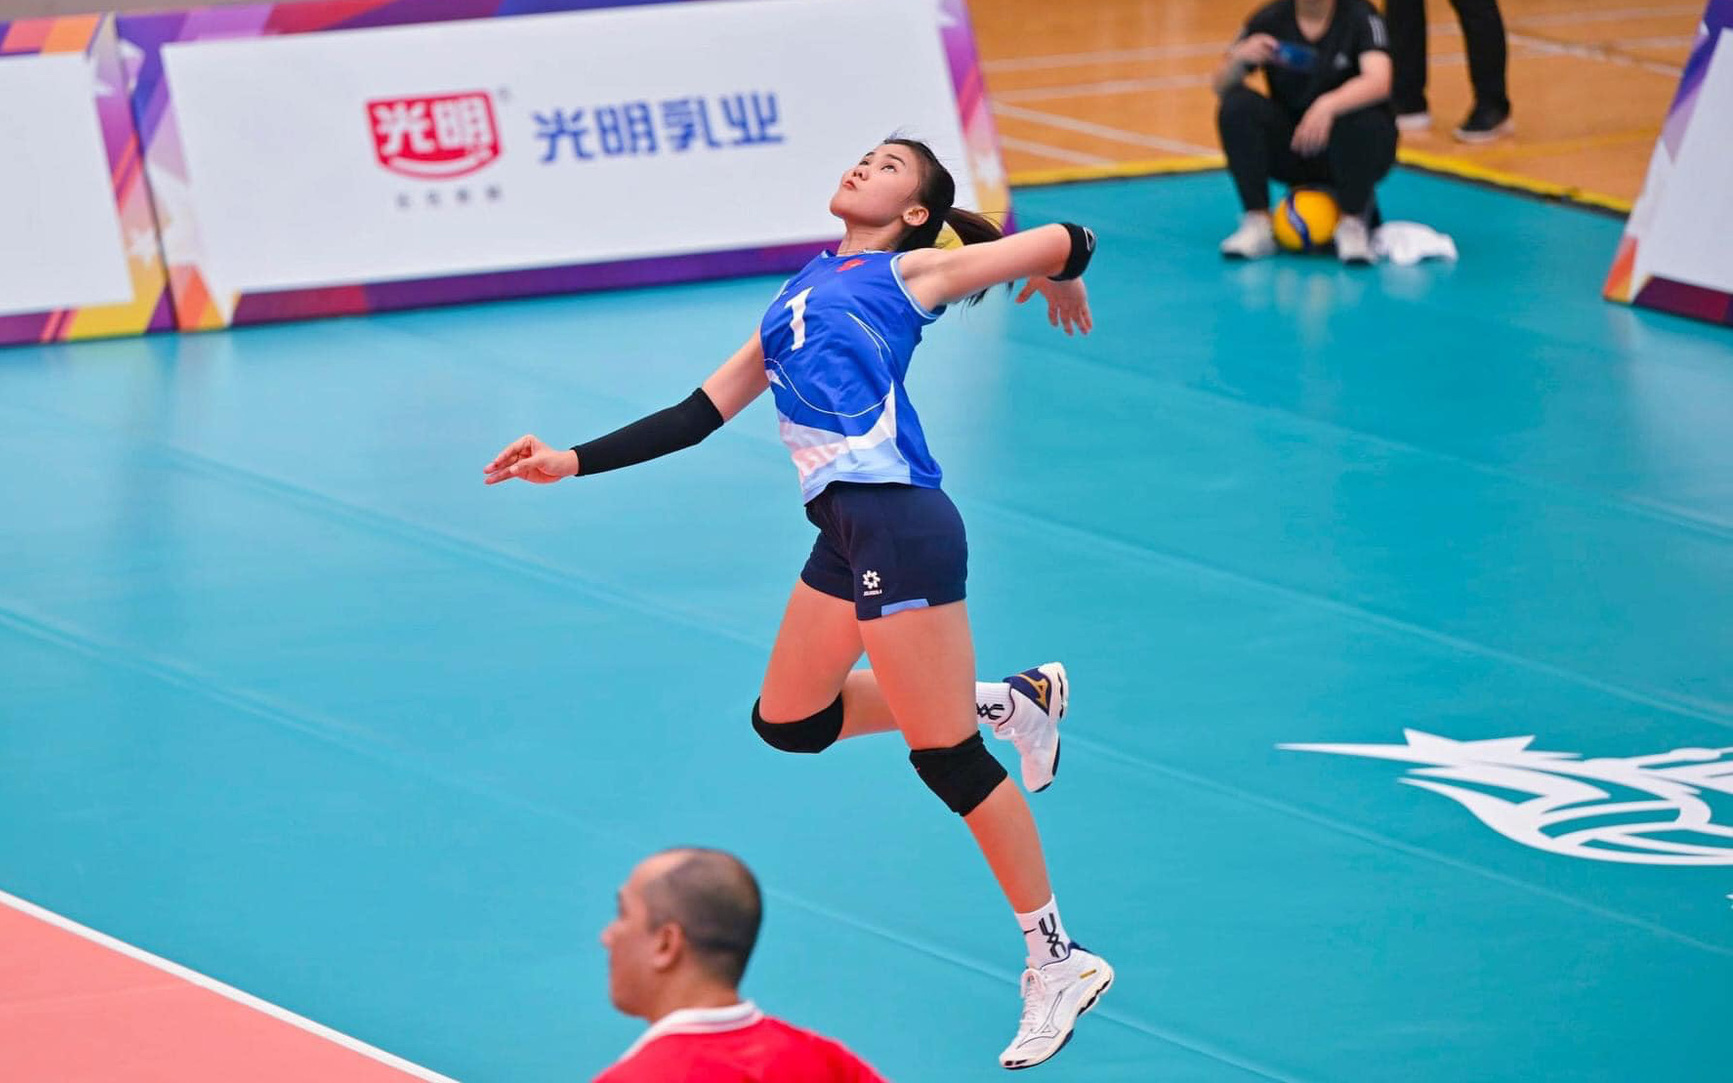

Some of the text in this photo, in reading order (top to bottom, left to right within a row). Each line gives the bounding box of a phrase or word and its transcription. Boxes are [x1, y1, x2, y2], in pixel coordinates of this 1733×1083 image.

[372, 97, 494, 155] 光明
[532, 91, 785, 164] 光明乳业
[784, 286, 814, 352] 1
